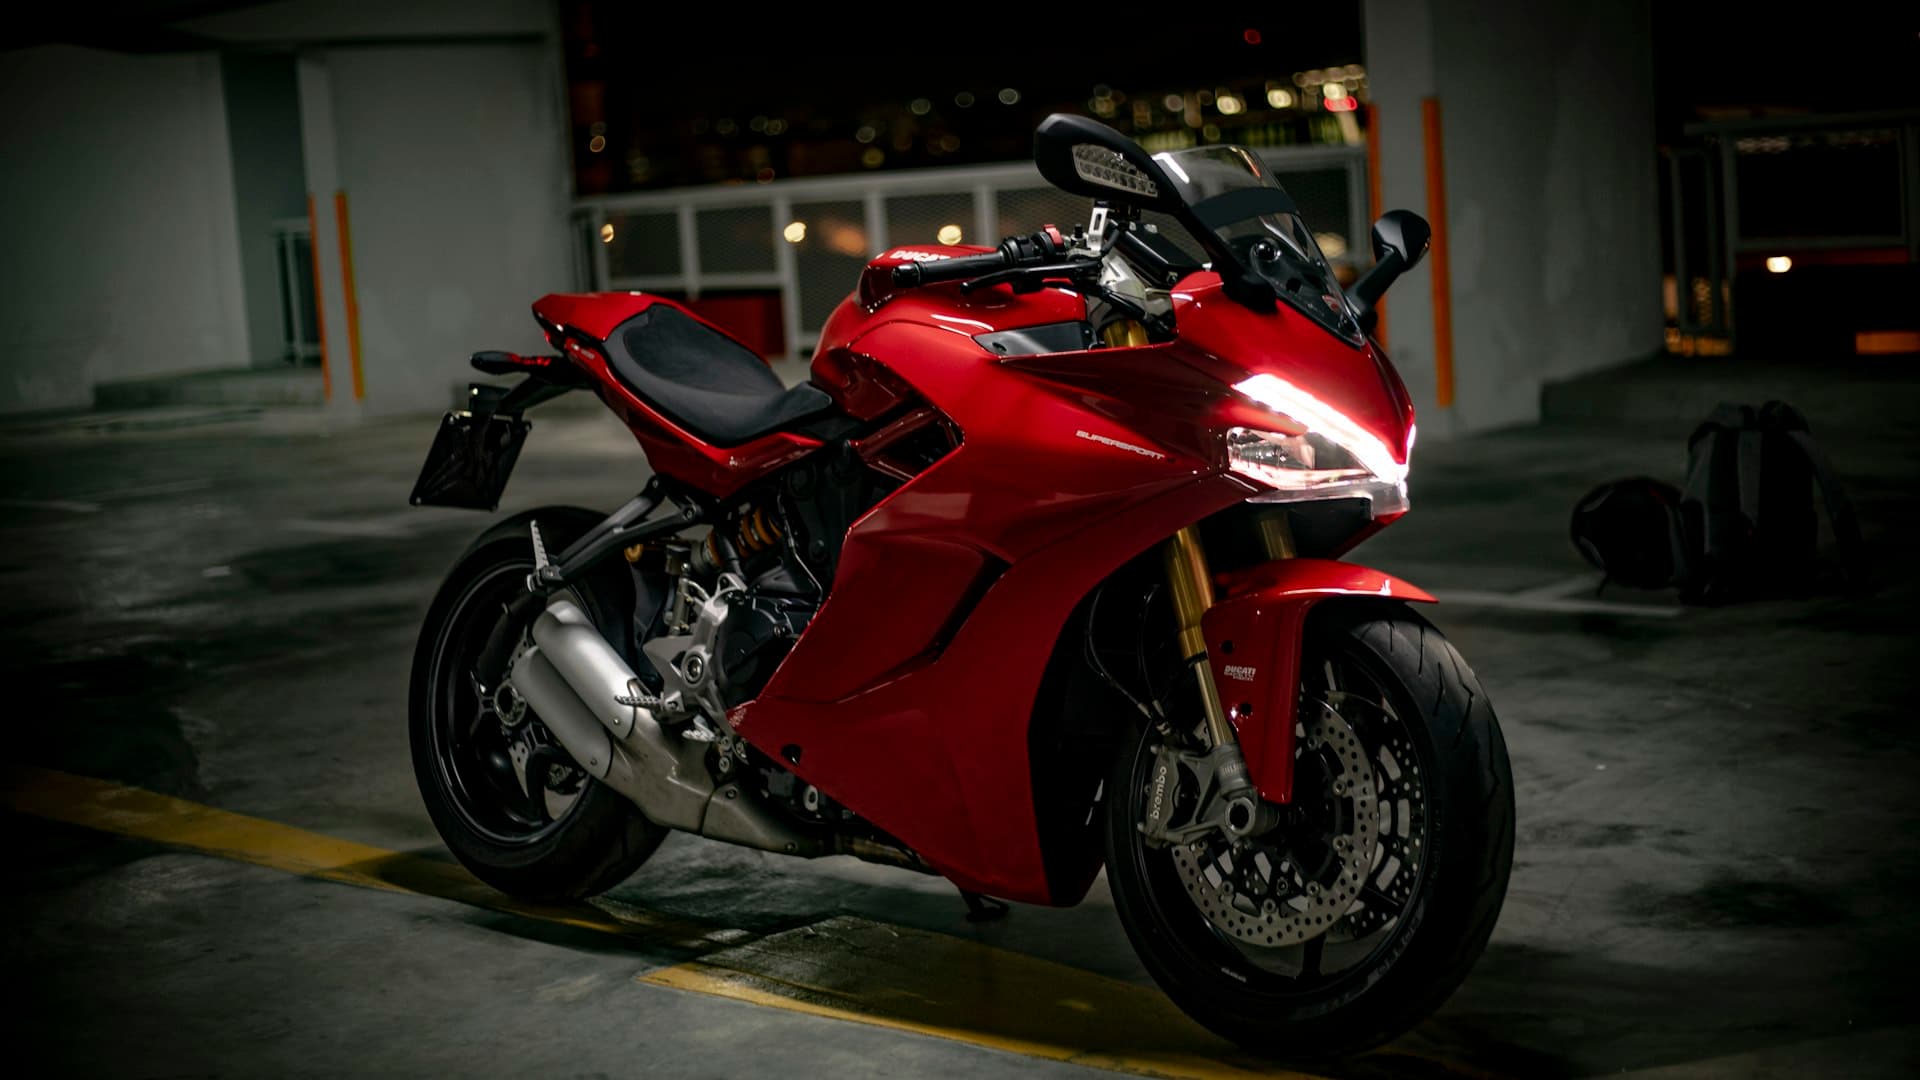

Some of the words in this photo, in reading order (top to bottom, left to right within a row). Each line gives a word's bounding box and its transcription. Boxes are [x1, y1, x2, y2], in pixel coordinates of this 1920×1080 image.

[1075, 430, 1165, 460] SUPERSPORT
[1224, 665, 1257, 676] DUCATI
[1149, 765, 1168, 819] brembo
